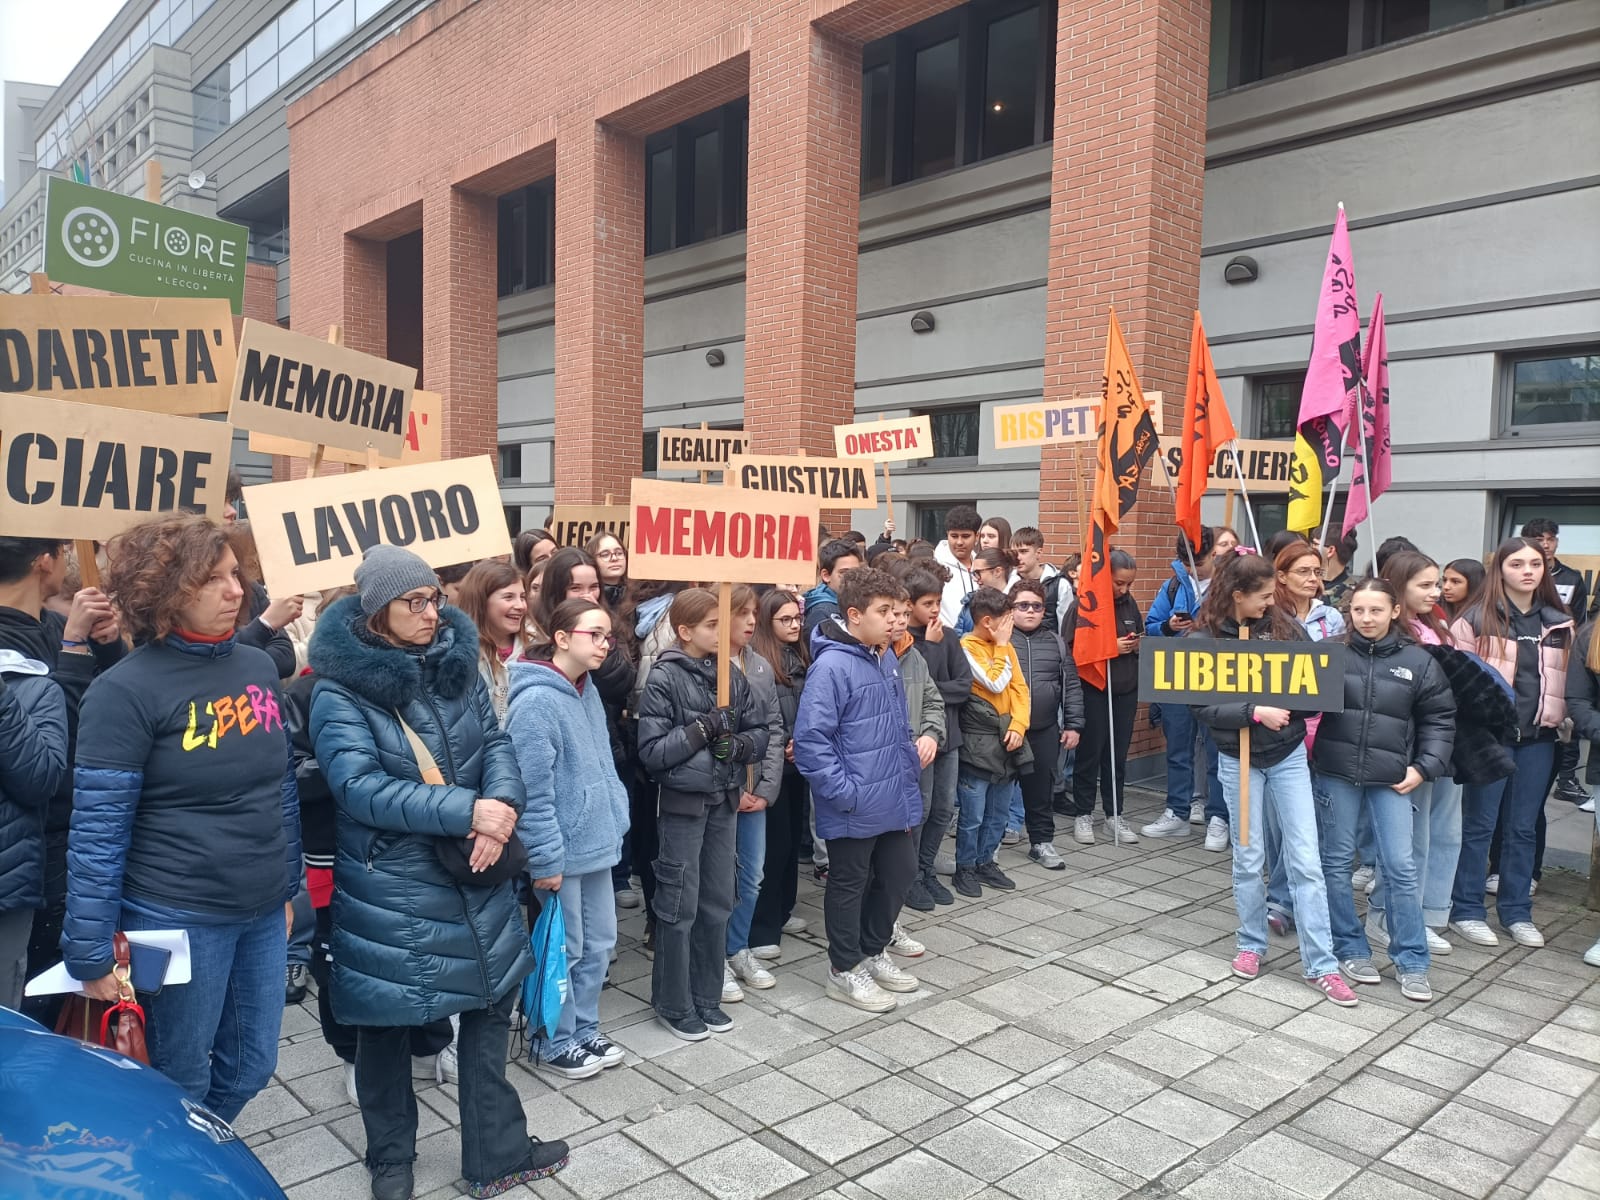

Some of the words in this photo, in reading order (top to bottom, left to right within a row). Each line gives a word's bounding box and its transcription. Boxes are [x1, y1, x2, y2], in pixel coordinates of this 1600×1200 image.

[130, 217, 236, 267] FIORE
[129, 253, 172, 269] CUCINA
[177, 264, 188, 273] IN
[192, 267, 234, 284] LIBERTÀ
[164, 277, 200, 291] LECCO
[239, 348, 405, 436] MEMORIA
[662, 436, 749, 463] LEGALITA'
[845, 427, 921, 456] ONESTA'
[741, 464, 869, 499] GIUSTIZIA
[281, 484, 480, 567] LAVORO
[635, 505, 813, 562] MEMORIA
[1153, 651, 1329, 695] LIBERTA'
